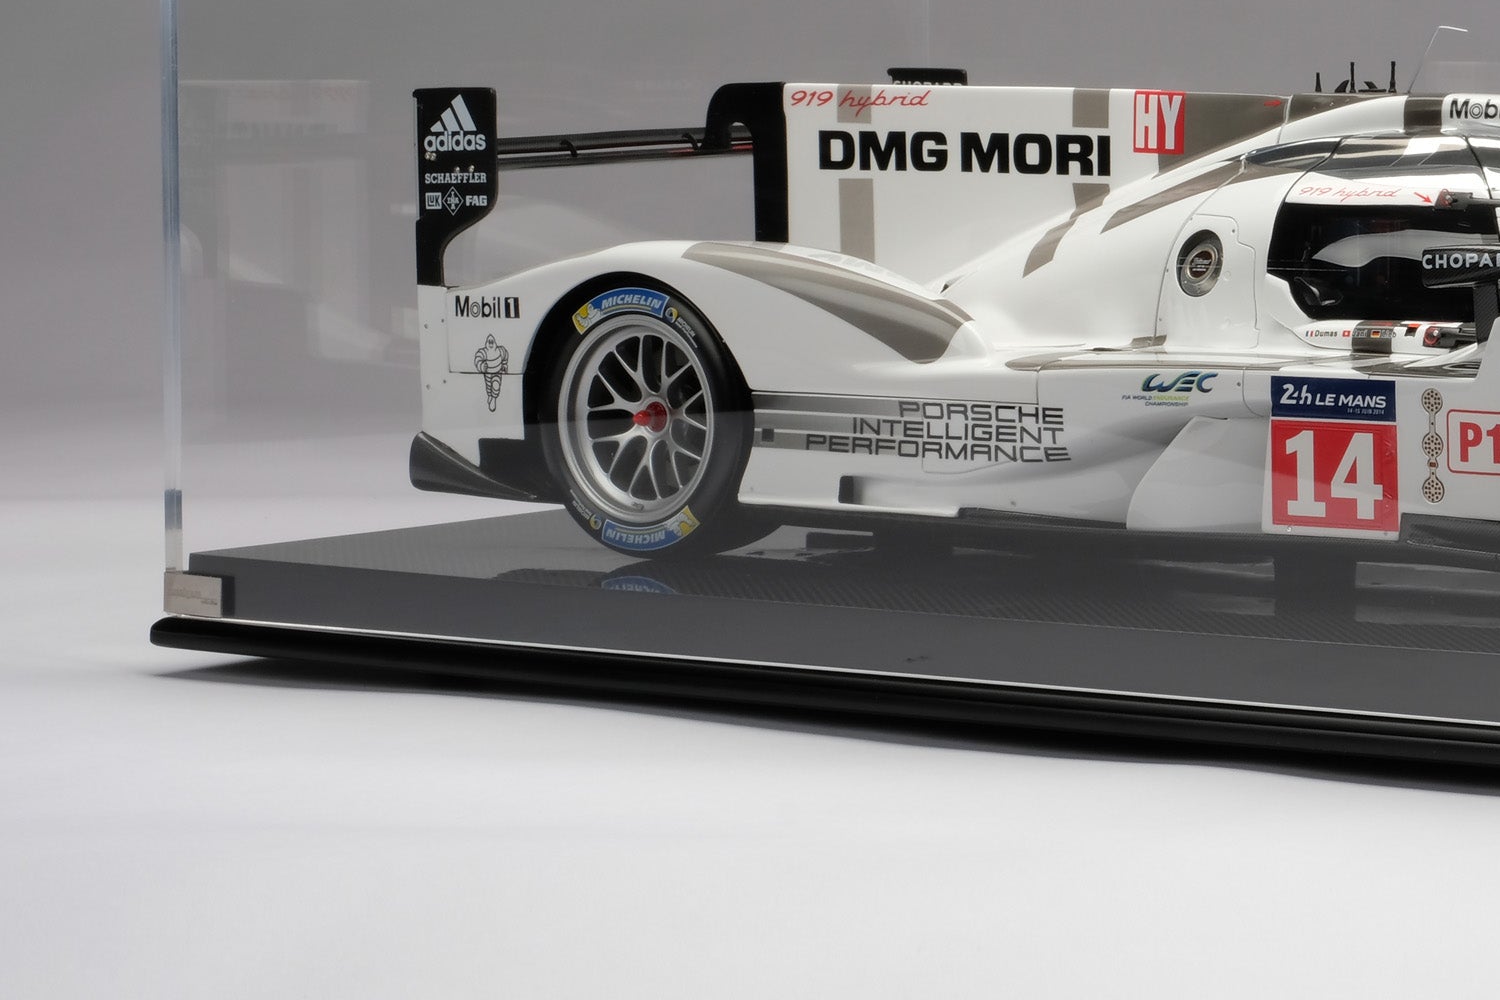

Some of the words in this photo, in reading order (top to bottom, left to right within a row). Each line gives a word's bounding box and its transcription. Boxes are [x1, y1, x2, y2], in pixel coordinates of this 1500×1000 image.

[791, 90, 833, 107] 919
[838, 89, 932, 117] hybrid
[1135, 93, 1182, 150] HY
[424, 131, 486, 151] adidas
[819, 130, 948, 172] DMG
[960, 132, 1111, 177] MORI
[425, 172, 487, 184] SCHAEFFLER
[465, 195, 488, 206] FAG
[1300, 186, 1332, 196] 919
[455, 295, 501, 319] Mobil
[601, 294, 662, 310] MICHELIN
[1141, 370, 1219, 393] WEC
[899, 400, 1064, 425] PORSCHE
[1315, 393, 1337, 406] LE
[1338, 394, 1387, 409] MANS
[852, 416, 1064, 444] INTELLIGENT
[806, 433, 1071, 463] PERFORMANCE
[1285, 429, 1384, 520] 14
[605, 528, 666, 544] MICHELIN
